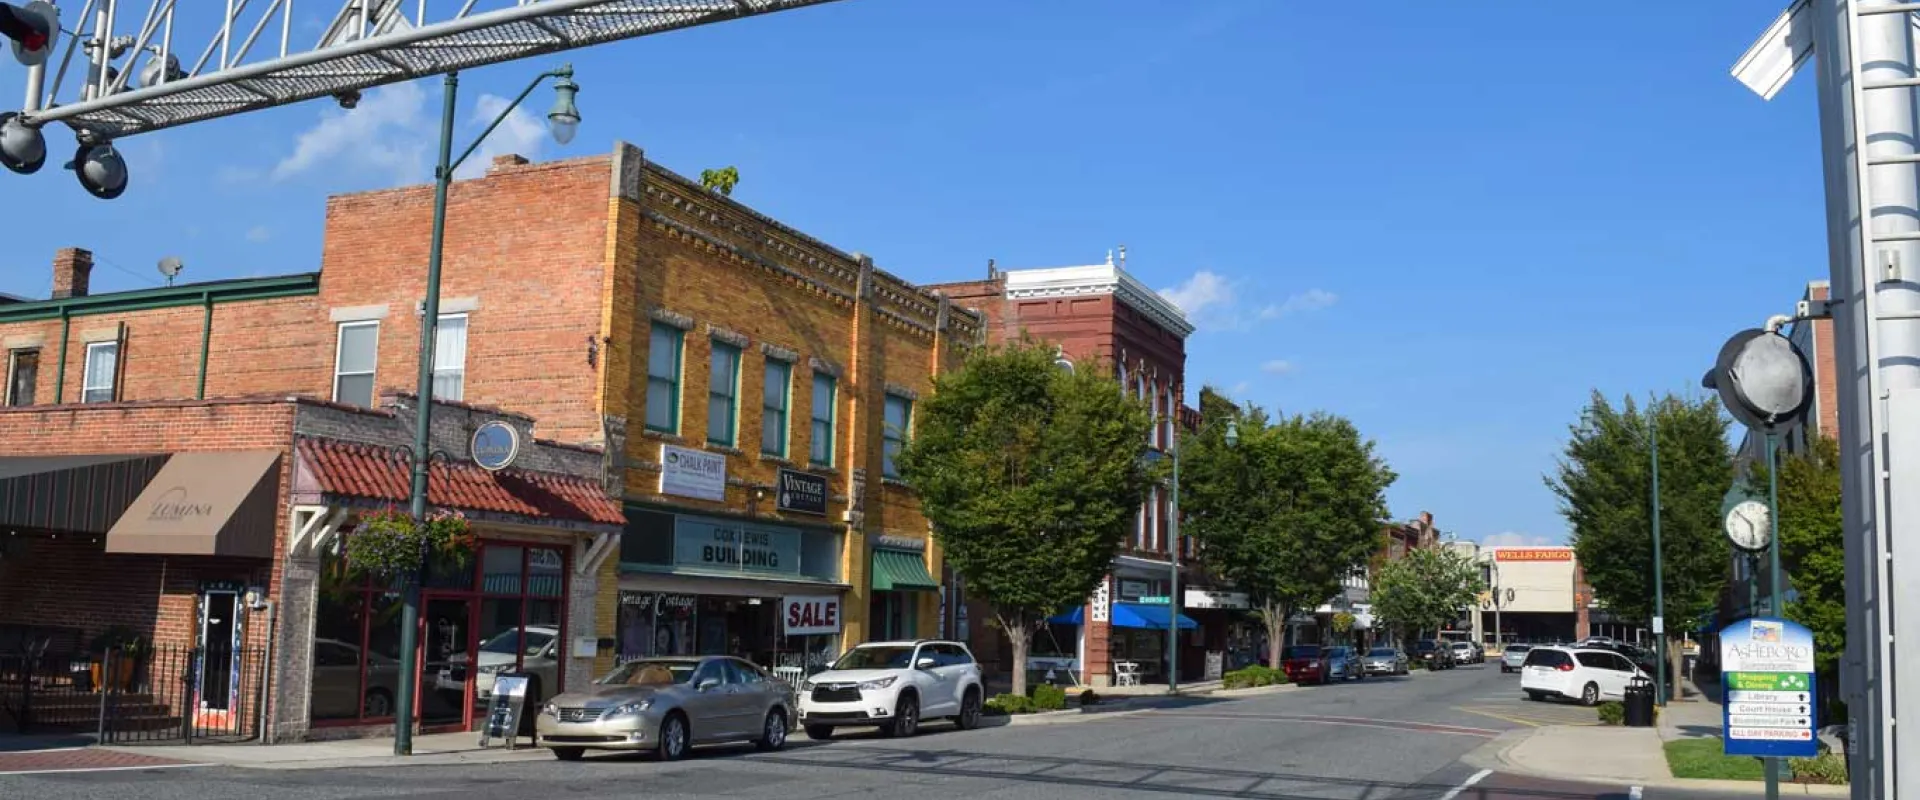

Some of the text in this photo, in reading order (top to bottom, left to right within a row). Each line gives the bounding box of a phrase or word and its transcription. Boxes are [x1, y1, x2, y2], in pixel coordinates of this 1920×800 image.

[783, 474, 822, 494] VINTAGE
[713, 528, 735, 542] COX
[703, 545, 779, 568] BUILDING
[1497, 551, 1570, 559] WELLS FARGO
[787, 601, 837, 628] SALE
[1748, 692, 1777, 701] Library
